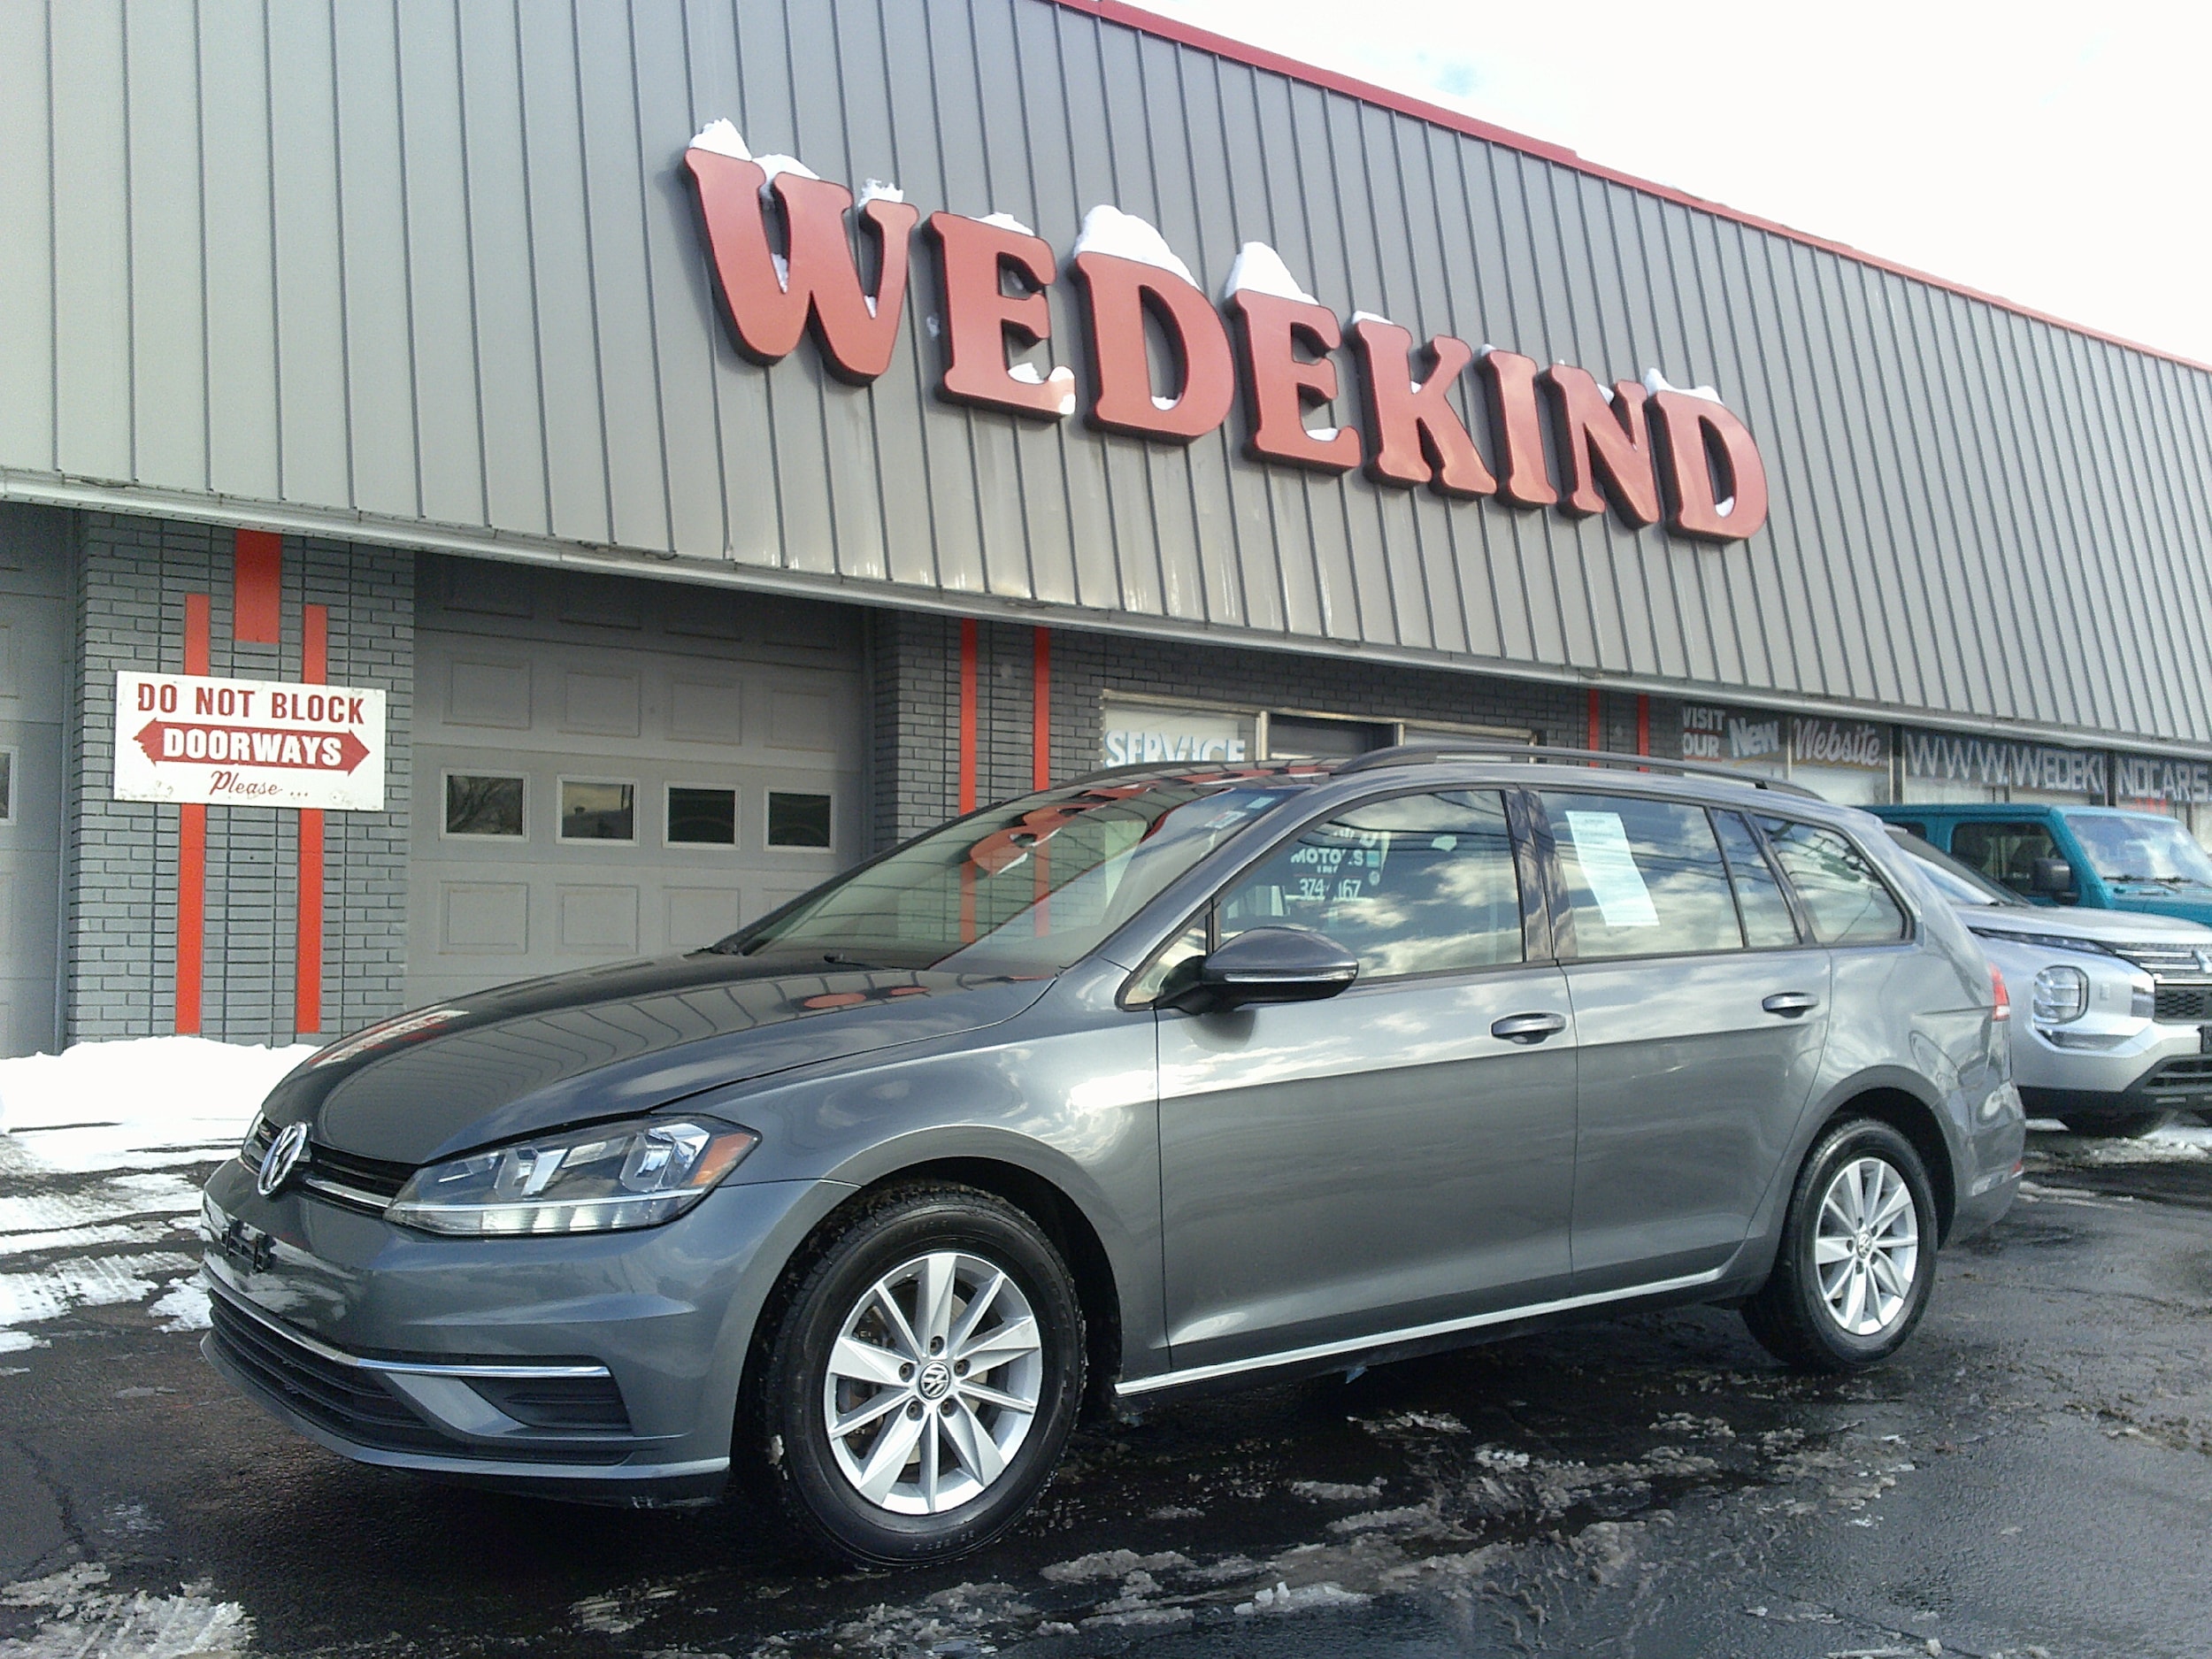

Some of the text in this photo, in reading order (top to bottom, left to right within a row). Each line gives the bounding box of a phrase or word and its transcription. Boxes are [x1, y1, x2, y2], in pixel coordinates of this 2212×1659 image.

[686, 147, 1768, 542] WEDEKIND
[138, 683, 365, 725] DO NOT BLOCK
[1683, 707, 1724, 731] VISIT
[163, 727, 342, 766] DOORWAYS
[1105, 731, 1245, 768] SERVICE
[1683, 732, 1720, 758] OUR
[1291, 848, 1363, 866] MOTOS
